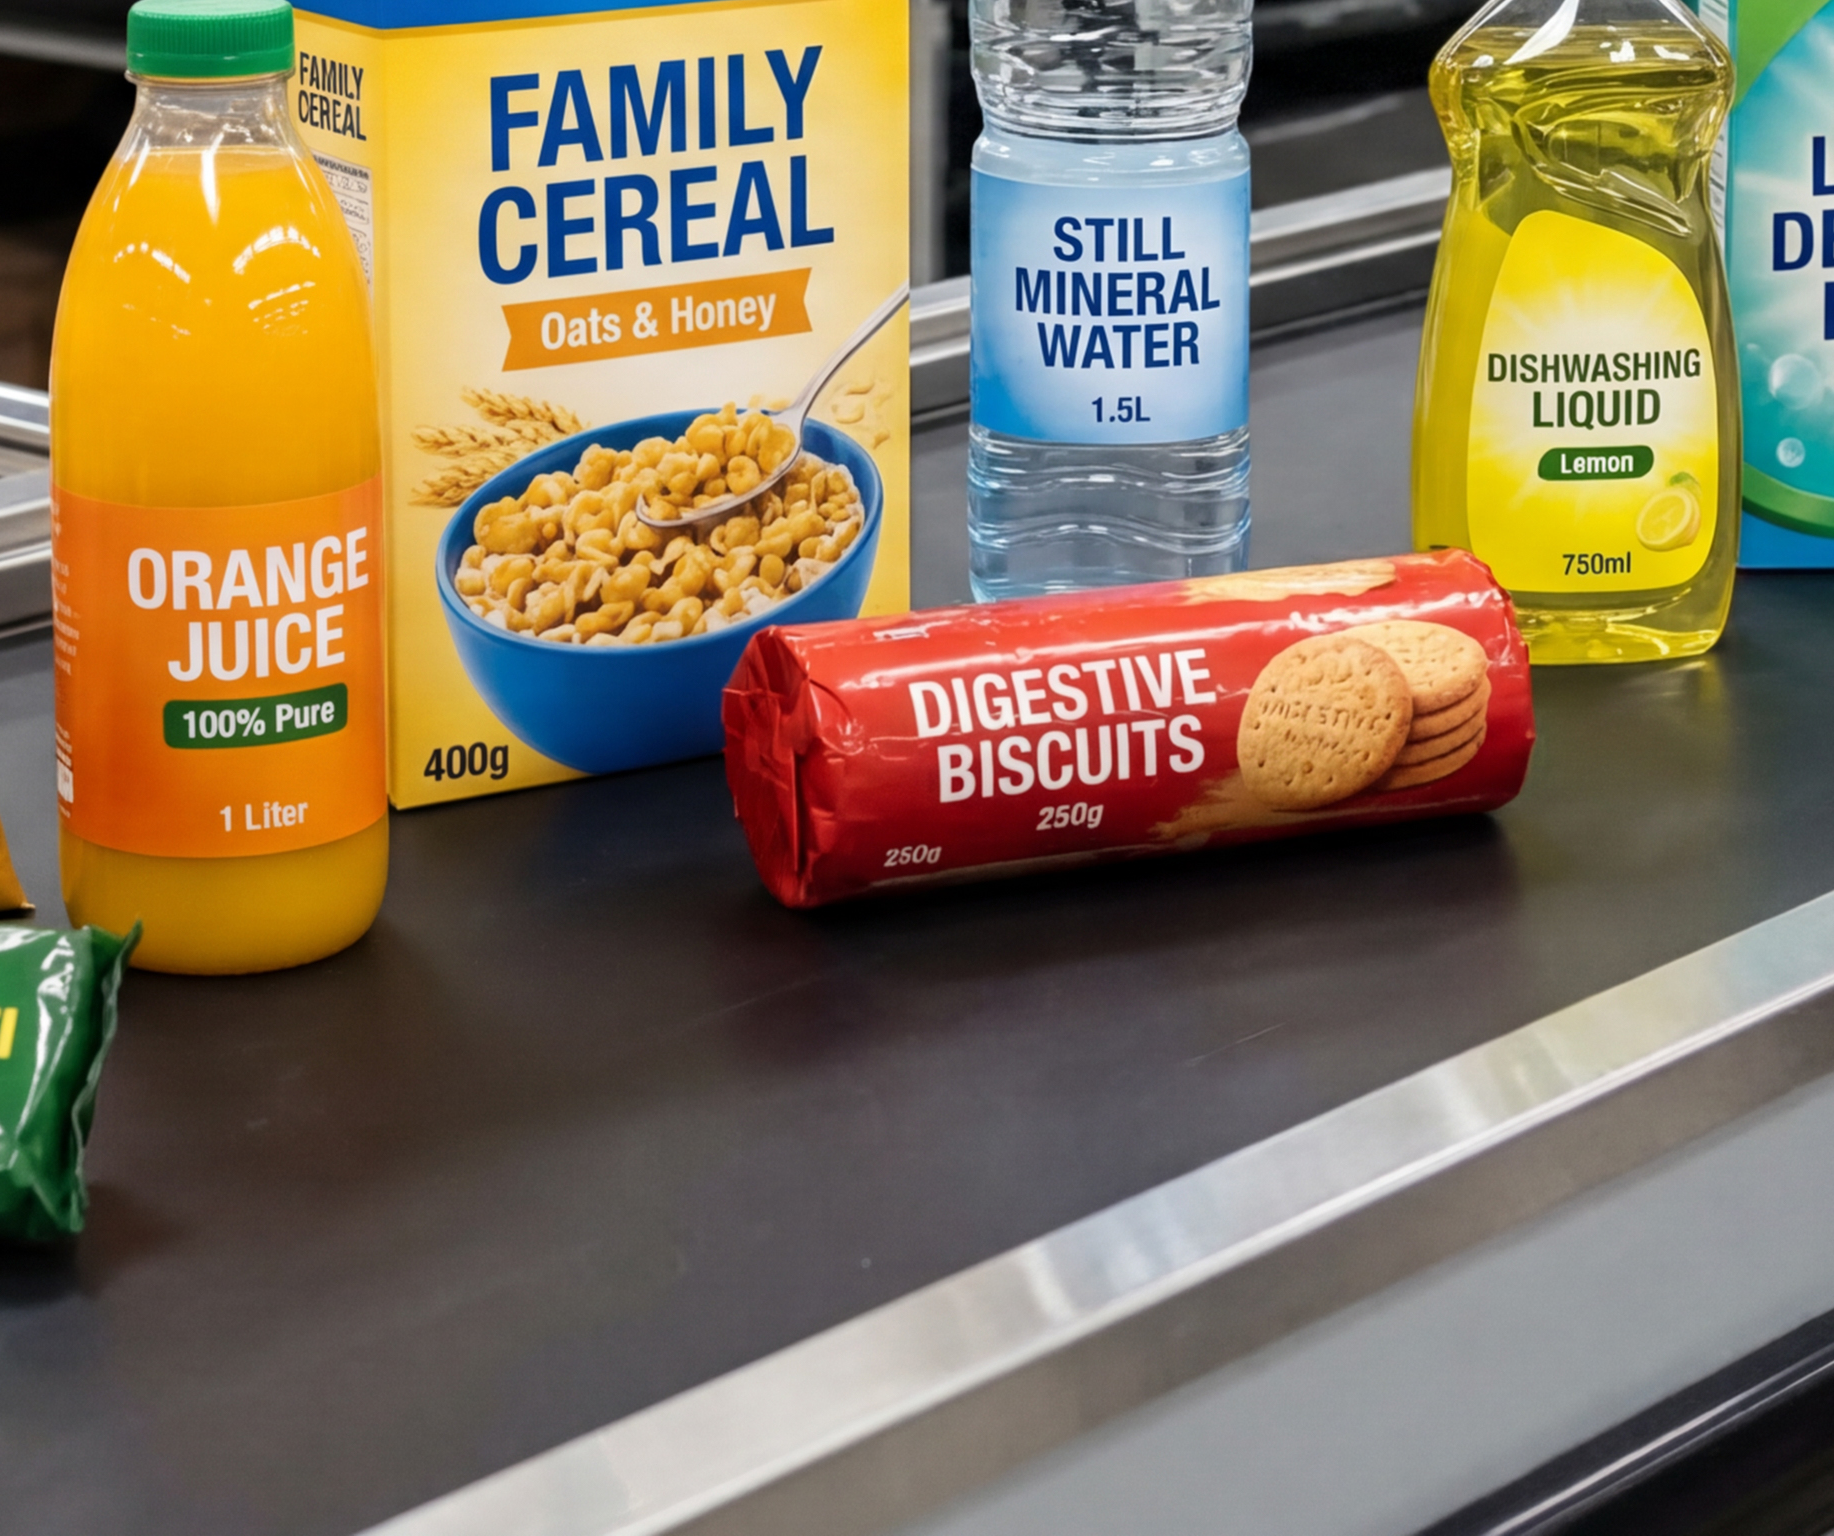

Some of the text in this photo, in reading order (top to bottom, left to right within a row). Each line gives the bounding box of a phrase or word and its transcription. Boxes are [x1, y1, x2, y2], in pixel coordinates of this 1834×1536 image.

[300, 51, 364, 101] FAMILY
[490, 45, 823, 173] FAMILY
[477, 155, 835, 286] CEREAL
[1053, 216, 1185, 262] STILL
[1015, 267, 1220, 317] MINERAL
[540, 293, 777, 352] Oats & Honey
[1037, 321, 1200, 369] WATER
[1487, 348, 1701, 383] DISHWASHING
[1091, 396, 1151, 422] 1.5L
[1533, 388, 1661, 430] LIQUID
[1560, 453, 1634, 474] Lemon
[127, 526, 369, 611] ORANGE
[1563, 551, 1631, 576] 750ml
[167, 604, 345, 682] JUICE
[908, 648, 1216, 740] DIGESTIVE
[182, 700, 335, 740] 100% Pure
[423, 741, 509, 782] 400g
[937, 715, 1206, 804] BISCUITS
[220, 801, 308, 832] 1 Liter
[1035, 802, 1104, 831] 250g
